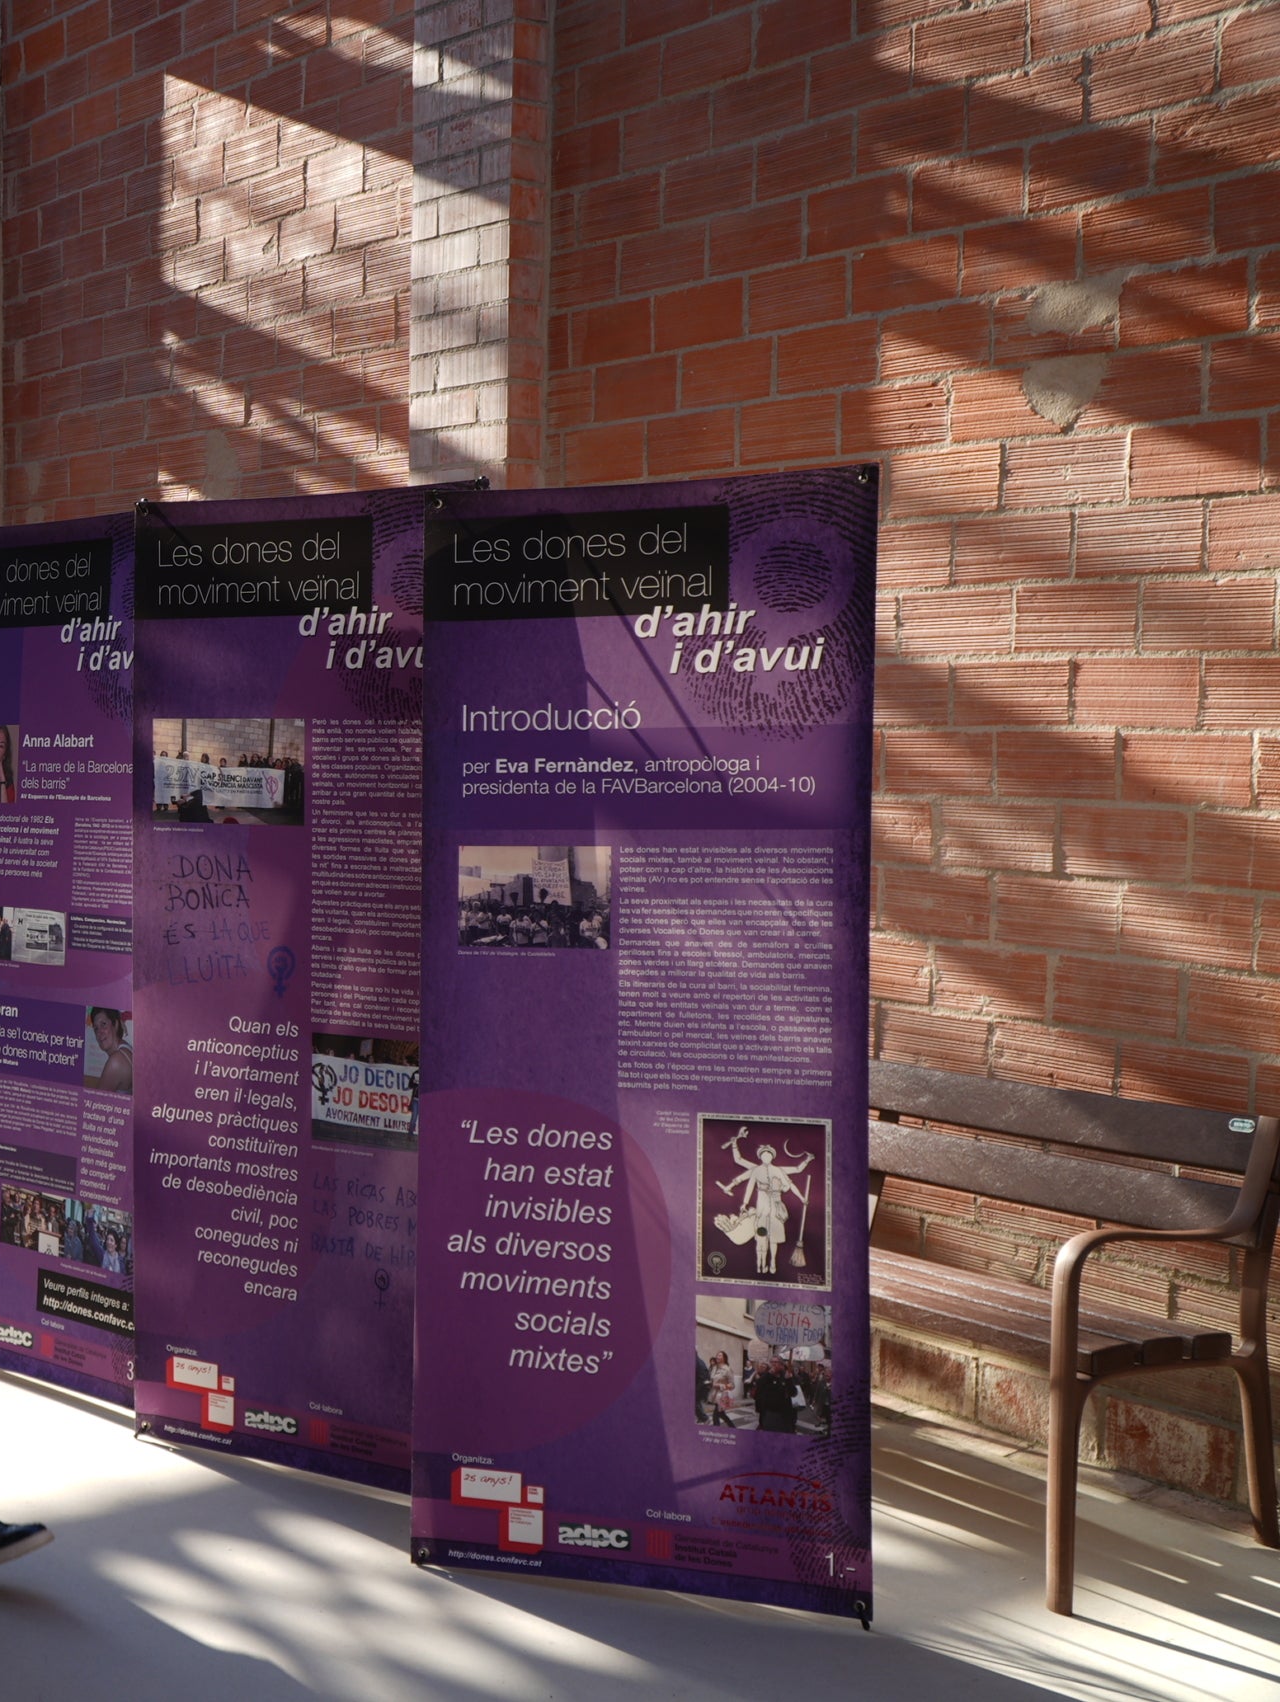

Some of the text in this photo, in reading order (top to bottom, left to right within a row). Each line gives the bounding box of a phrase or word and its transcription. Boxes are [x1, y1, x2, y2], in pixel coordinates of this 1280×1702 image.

[158, 531, 340, 567] Les dones del
[454, 522, 686, 563] Les dones del
[5, 558, 60, 583] dones
[64, 552, 91, 578] del
[158, 570, 359, 605] moviment veïnal
[454, 564, 711, 605] moviment veïnal
[54, 586, 102, 612] veïnal
[60, 616, 122, 642] d'ahir
[298, 605, 392, 636] d'ahir
[633, 601, 755, 638] d'ahir
[76, 648, 84, 671] i
[325, 642, 336, 669] i
[669, 636, 825, 673] i d'avui
[462, 699, 641, 731] Introducció
[22, 733, 94, 747] Anna Alabart
[38, 762, 61, 773] mare
[62, 760, 75, 773] de
[77, 761, 85, 773] la
[87, 761, 133, 774] Barcelona
[462, 755, 759, 777] per Eva Fernàndez, antropòloga i
[20, 777, 39, 789] dels
[462, 776, 815, 798] presidenta de la FAVBarcelona (2004-10)
[619, 845, 634, 853] Les
[790, 846, 834, 854] moviments
[172, 854, 253, 881] DONA
[6, 1027, 20, 1039] se'l
[21, 1030, 48, 1043] coneix
[50, 1034, 64, 1046] per
[65, 1034, 84, 1048] tenir
[228, 1015, 299, 1037] Quan els
[2, 1045, 27, 1060] dones
[28, 1049, 47, 1061] molt
[186, 1039, 298, 1061] anticonceptius
[194, 1060, 299, 1085] i l'avortament
[339, 1065, 359, 1084] JO
[194, 1086, 296, 1112] eren il·legals,
[333, 1088, 354, 1105] JO
[151, 1104, 298, 1133] algunes pràctiques
[326, 1107, 380, 1126] AVORTAMENT
[207, 1134, 298, 1157] constituïren
[527, 1123, 612, 1150] dones
[149, 1148, 298, 1181] importants mostres
[484, 1156, 613, 1187] han estat
[161, 1173, 297, 1205] de desobediència
[230, 1207, 298, 1229] civil, poc
[485, 1194, 612, 1225] invisibles
[194, 1226, 298, 1253] conegudes ni
[447, 1230, 611, 1262] als diversos
[197, 1250, 298, 1277] reconegudes
[43, 1278, 65, 1293] Veure
[66, 1286, 89, 1300] perfils
[121, 1301, 129, 1311] a:
[244, 1281, 297, 1301] encara
[460, 1271, 611, 1299] moviments
[514, 1311, 611, 1337] socials
[126, 1360, 134, 1380] 3
[719, 1484, 832, 1512] ATLANTIS
